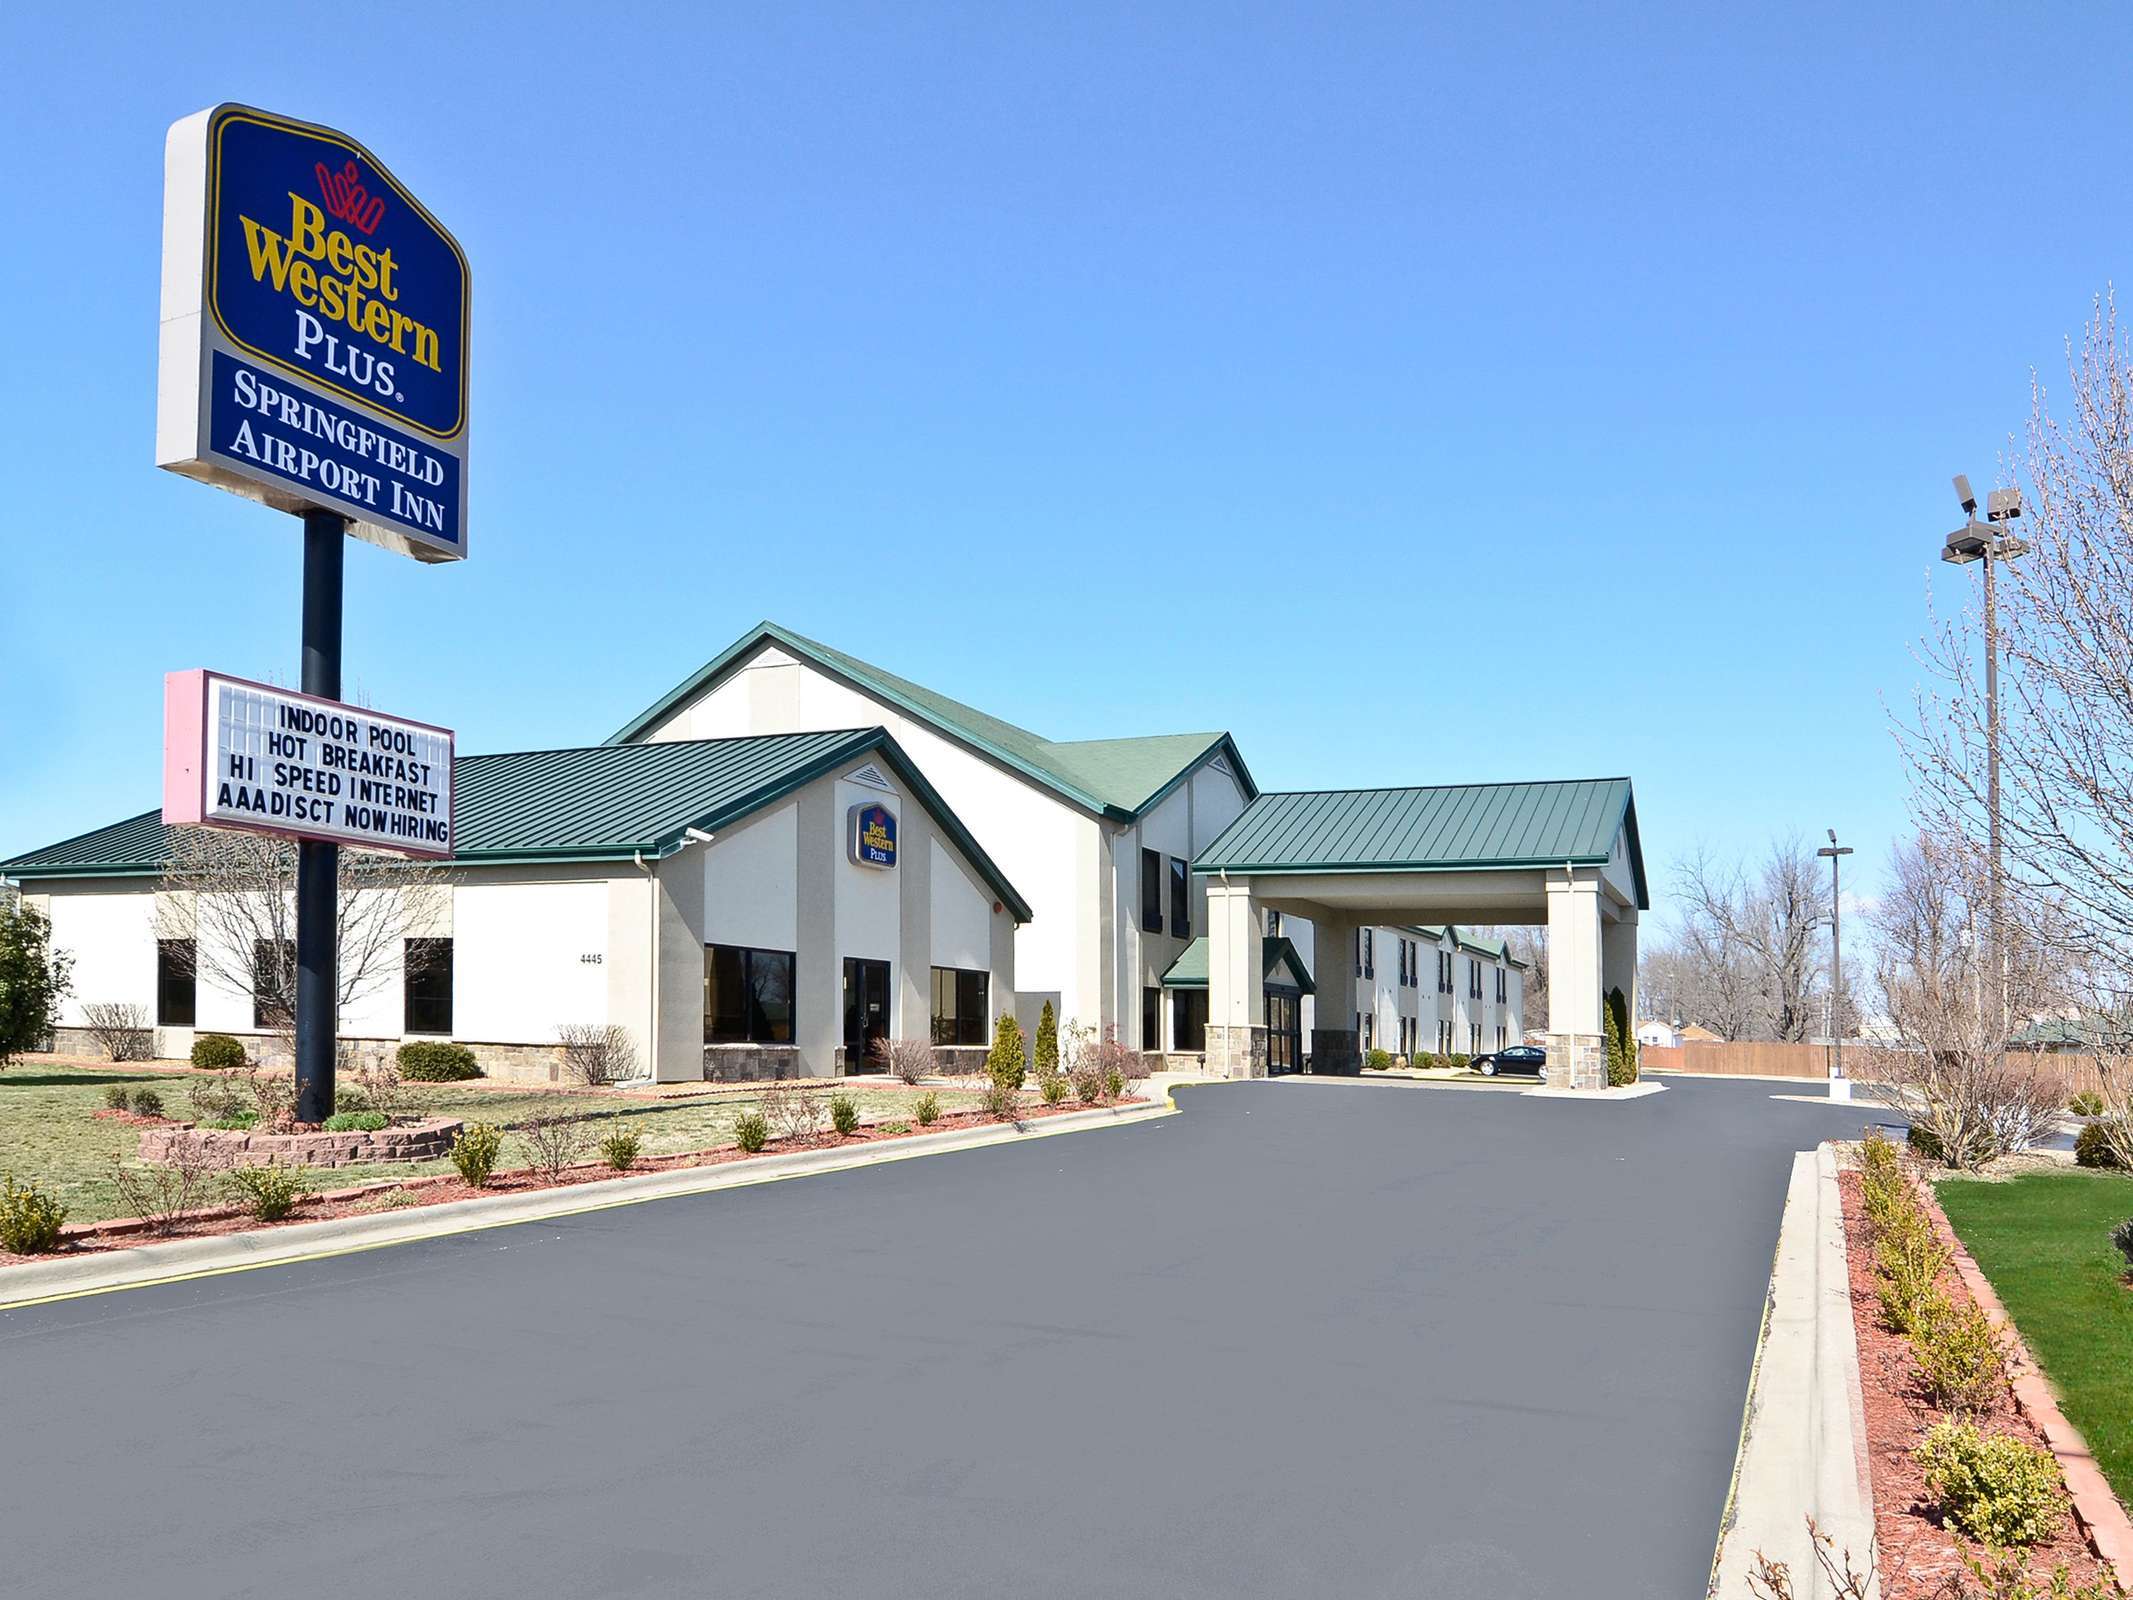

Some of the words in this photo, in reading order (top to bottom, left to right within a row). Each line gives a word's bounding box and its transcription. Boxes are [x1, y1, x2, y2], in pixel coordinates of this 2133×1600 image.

[288, 191, 399, 302] Best
[239, 214, 441, 373] Western
[234, 369, 444, 487] SPRINGFIELD
[229, 419, 380, 506] AIRPORT
[391, 479, 443, 531] INN
[268, 731, 307, 761] HOT
[322, 744, 430, 786] BREAKFAST
[280, 705, 358, 744] INDOOR
[369, 725, 415, 757] POOL
[230, 754, 253, 781] HI
[274, 763, 341, 796] SPEED
[351, 777, 438, 814] INTERNET
[863, 830, 894, 852] Western
[869, 821, 887, 838] Best
[580, 953, 602, 965] 4445
